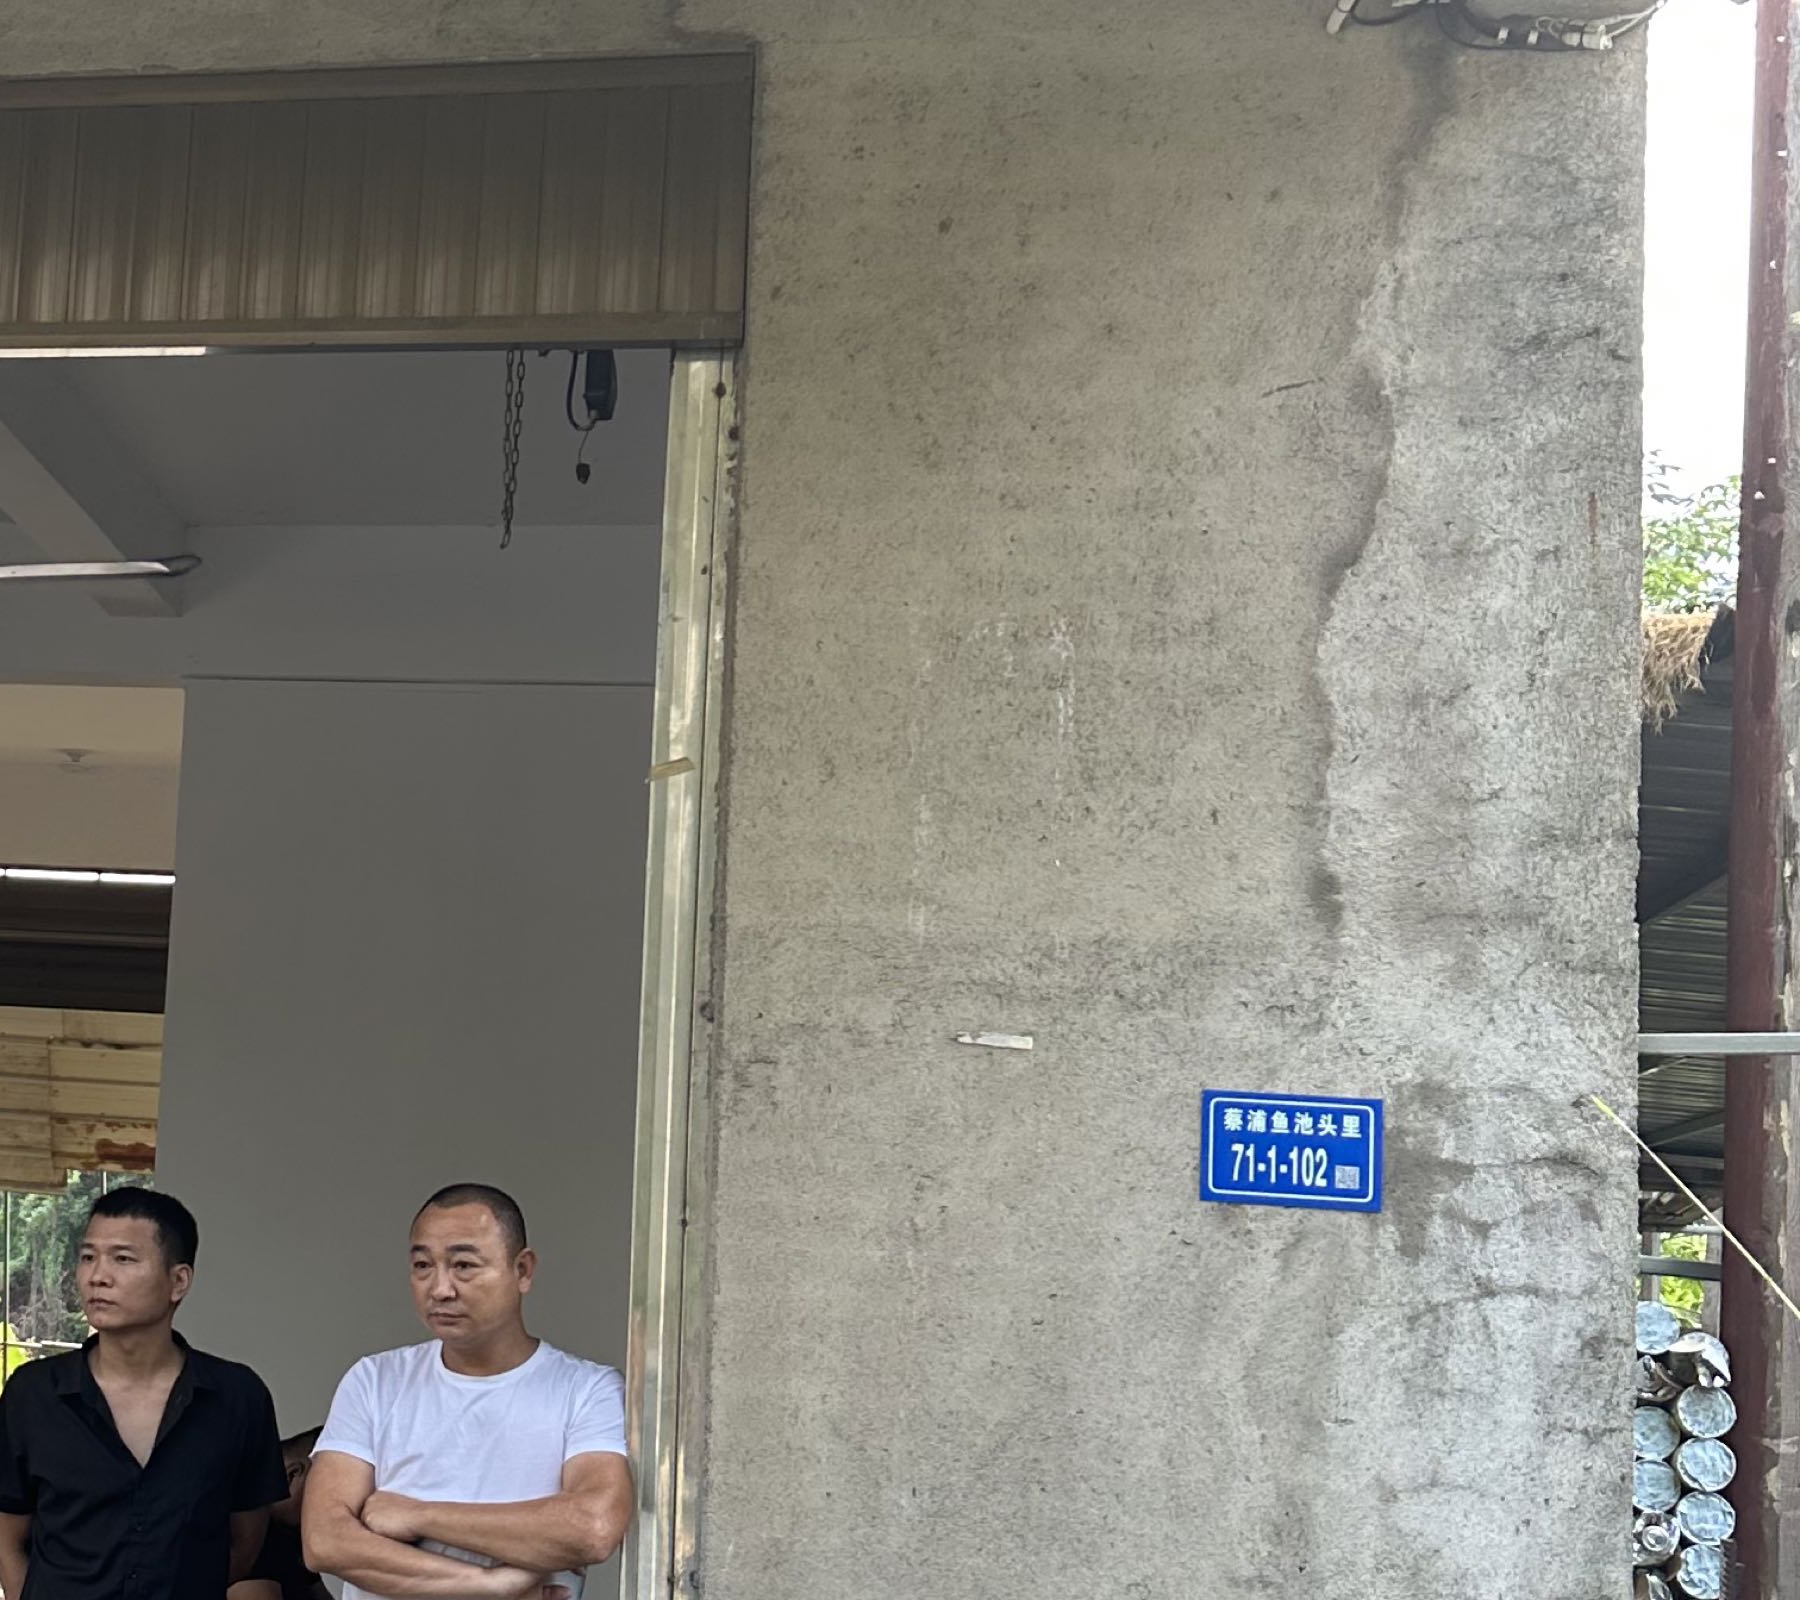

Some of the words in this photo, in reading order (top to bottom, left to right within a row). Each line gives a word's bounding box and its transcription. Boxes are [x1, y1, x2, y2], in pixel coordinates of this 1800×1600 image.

[1223, 1107, 1363, 1139] 蔡浦鱼池头里
[1230, 1142, 1328, 1188] 71-1-102
